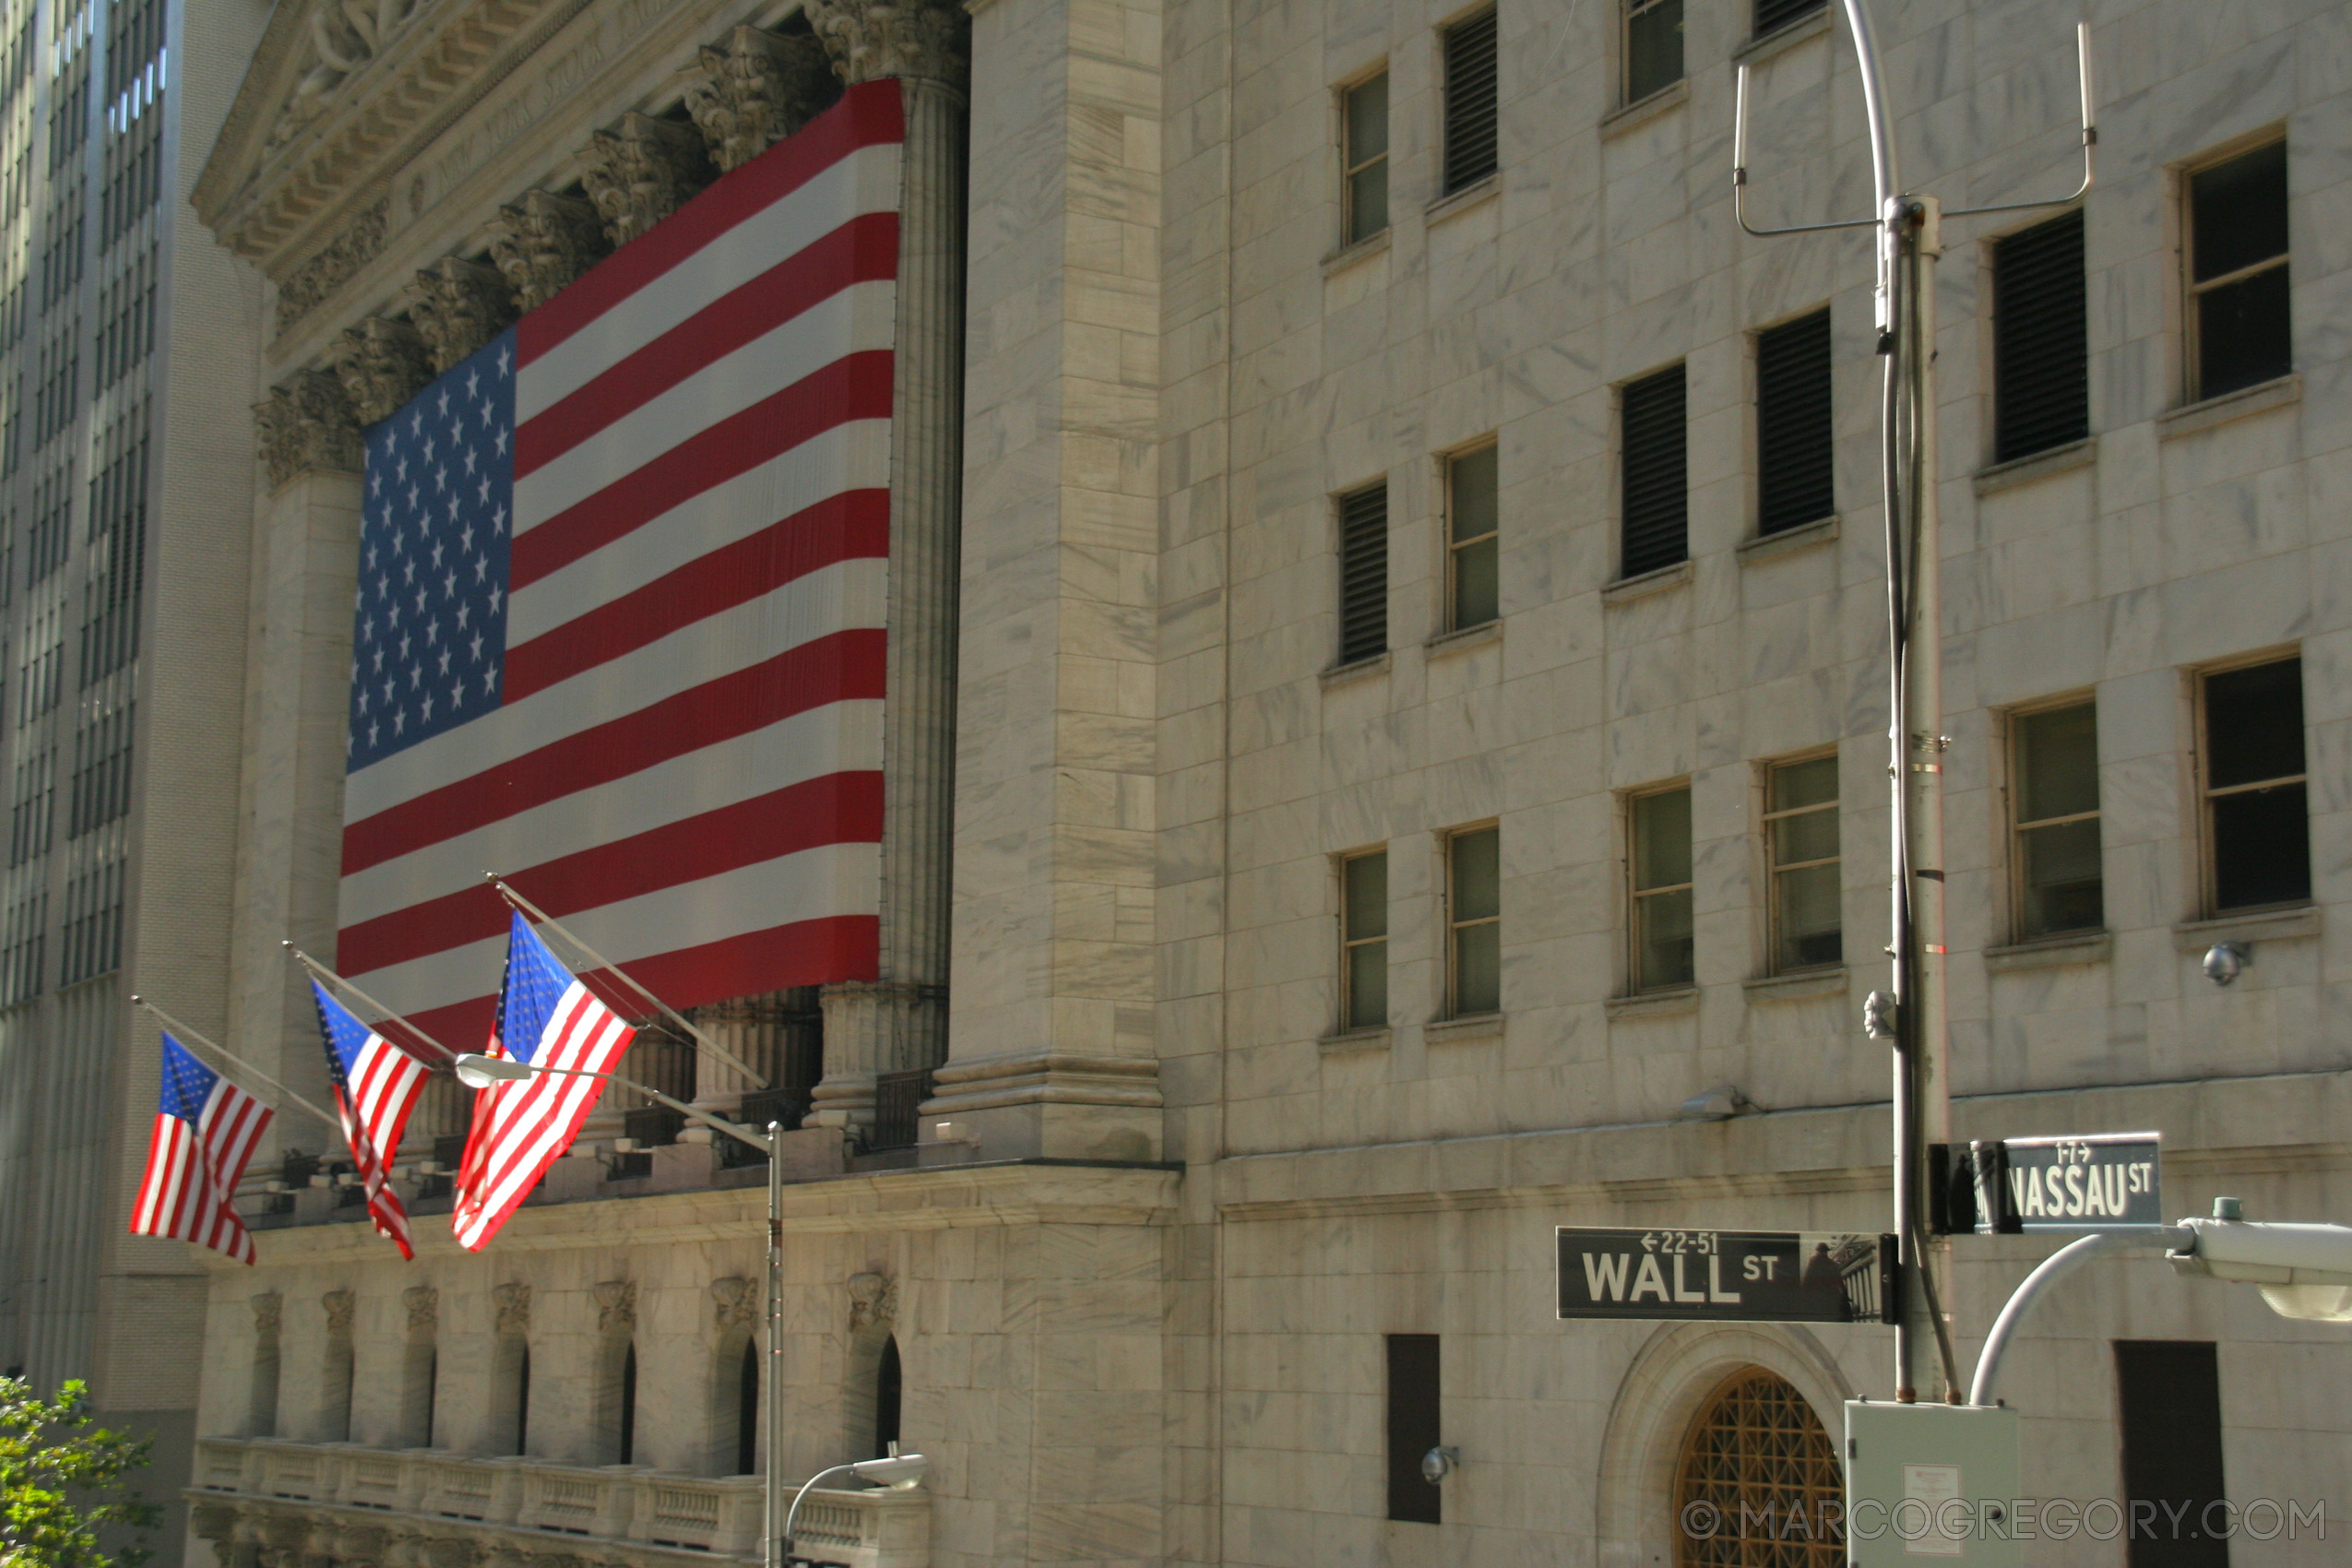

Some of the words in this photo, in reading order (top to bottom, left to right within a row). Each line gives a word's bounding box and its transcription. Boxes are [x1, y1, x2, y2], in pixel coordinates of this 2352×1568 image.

[2129, 1163, 2151, 1192] ST
[1660, 1231, 1717, 1253] 22-51
[1582, 1253, 1740, 1302] WALL
[1742, 1255, 1778, 1280] ST
